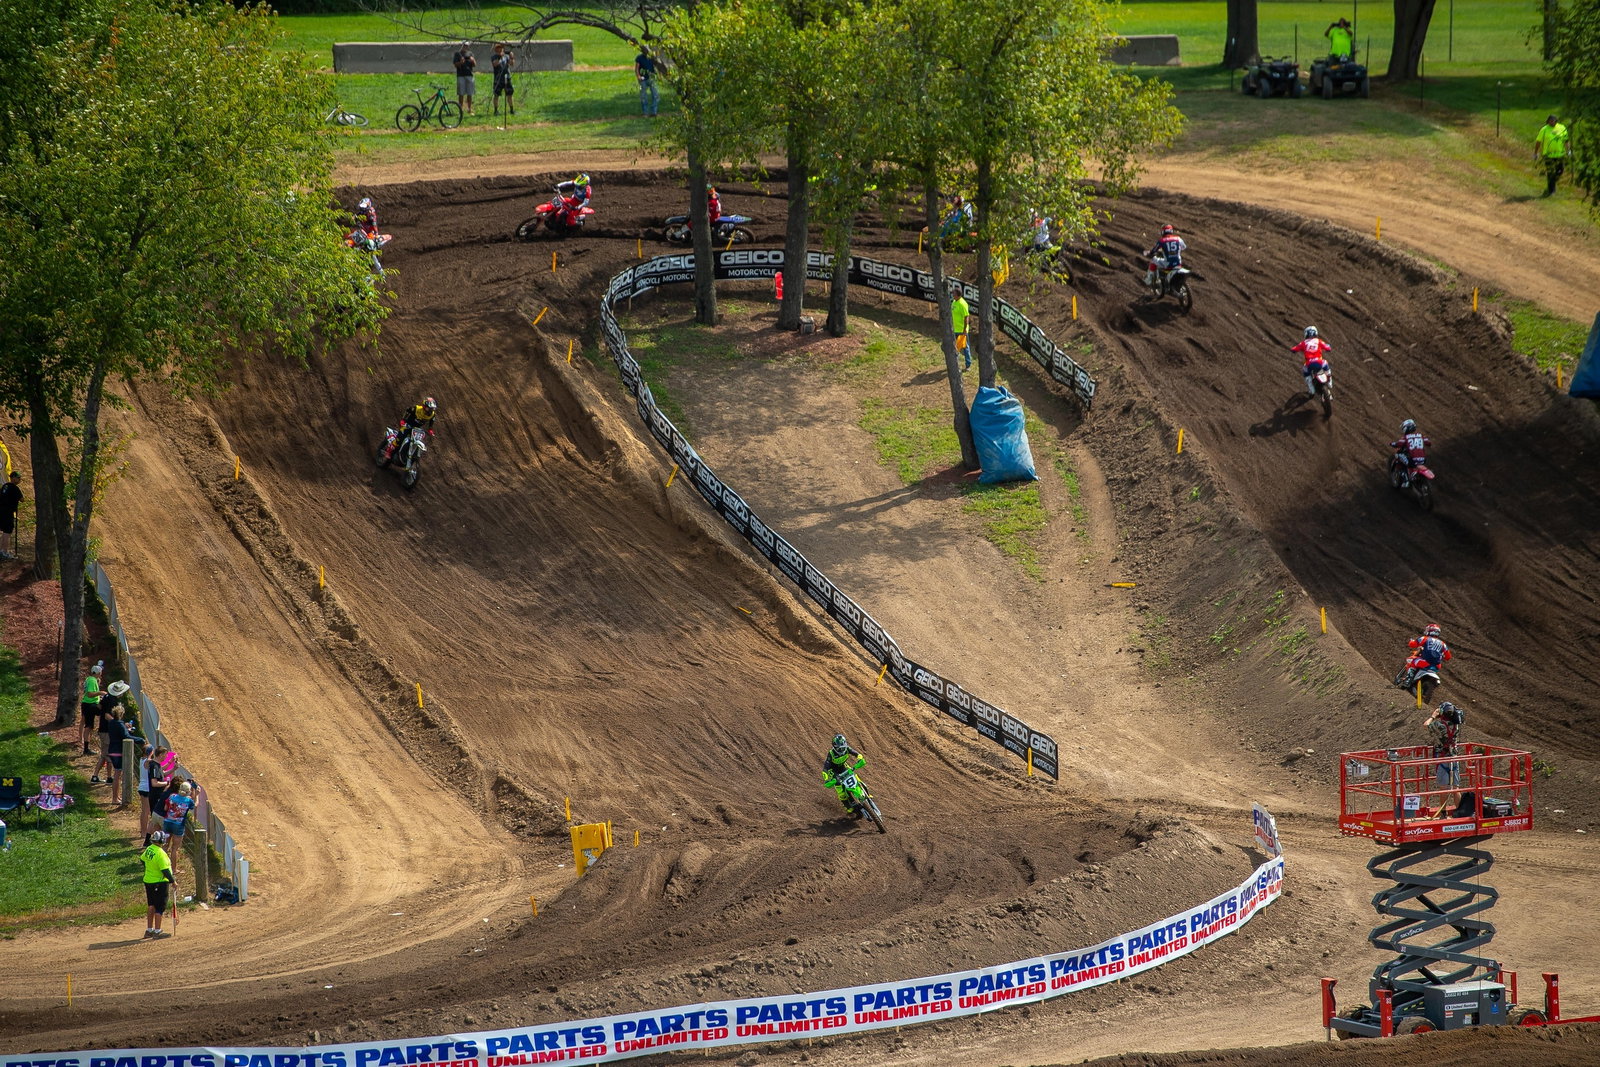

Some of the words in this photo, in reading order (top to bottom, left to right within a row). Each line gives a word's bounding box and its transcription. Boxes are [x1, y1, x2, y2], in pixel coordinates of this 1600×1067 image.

[720, 250, 784, 264] GEICO
[1166, 241, 1178, 252] 15
[656, 255, 696, 272] GEIC
[663, 272, 696, 282] MOTORCY
[728, 268, 776, 276] MOTORCYCLE
[860, 260, 913, 283] GEICO
[867, 278, 906, 294] MOTORCYCLE
[1001, 304, 1028, 334] GEICO
[697, 462, 722, 496] GEICO
[723, 490, 748, 522] GEICO
[750, 515, 774, 547] GEICO
[776, 540, 803, 572] GEICO
[805, 565, 831, 596] GEICO
[834, 591, 860, 624] GEICO
[862, 618, 888, 652] GEICO
[914, 669, 944, 694] GEICO
[972, 698, 1000, 726] GEICO
[1001, 716, 1028, 744] GEICO
[3, 778, 14, 786] M
[846, 776, 856, 787] 9
[1343, 822, 1364, 831] SKYJACK
[1405, 828, 1434, 836] SKYJACK
[1191, 896, 1237, 933] PARTS
[1192, 912, 1237, 944] UNLIMITED
[1128, 919, 1186, 956] PARTS
[1400, 928, 1424, 938] SKYJACK
[1050, 942, 1124, 978] PARTS
[1128, 936, 1187, 968] UNLIMITED
[959, 963, 1046, 996] PARTS
[1051, 961, 1125, 990] UNLIMITED
[854, 982, 952, 1012] PARTS
[959, 982, 1046, 1008] UNLIMITED
[736, 996, 846, 1024] PARTS
[854, 999, 952, 1024] UNLIMITED
[614, 1009, 728, 1040] PARTS
[736, 1014, 848, 1037] UNLIMITED
[356, 1040, 478, 1067] PARTS
[487, 1025, 606, 1056] PARTS
[615, 1027, 728, 1053] UNLIMITED
[487, 1044, 608, 1067] UNLIMITED
